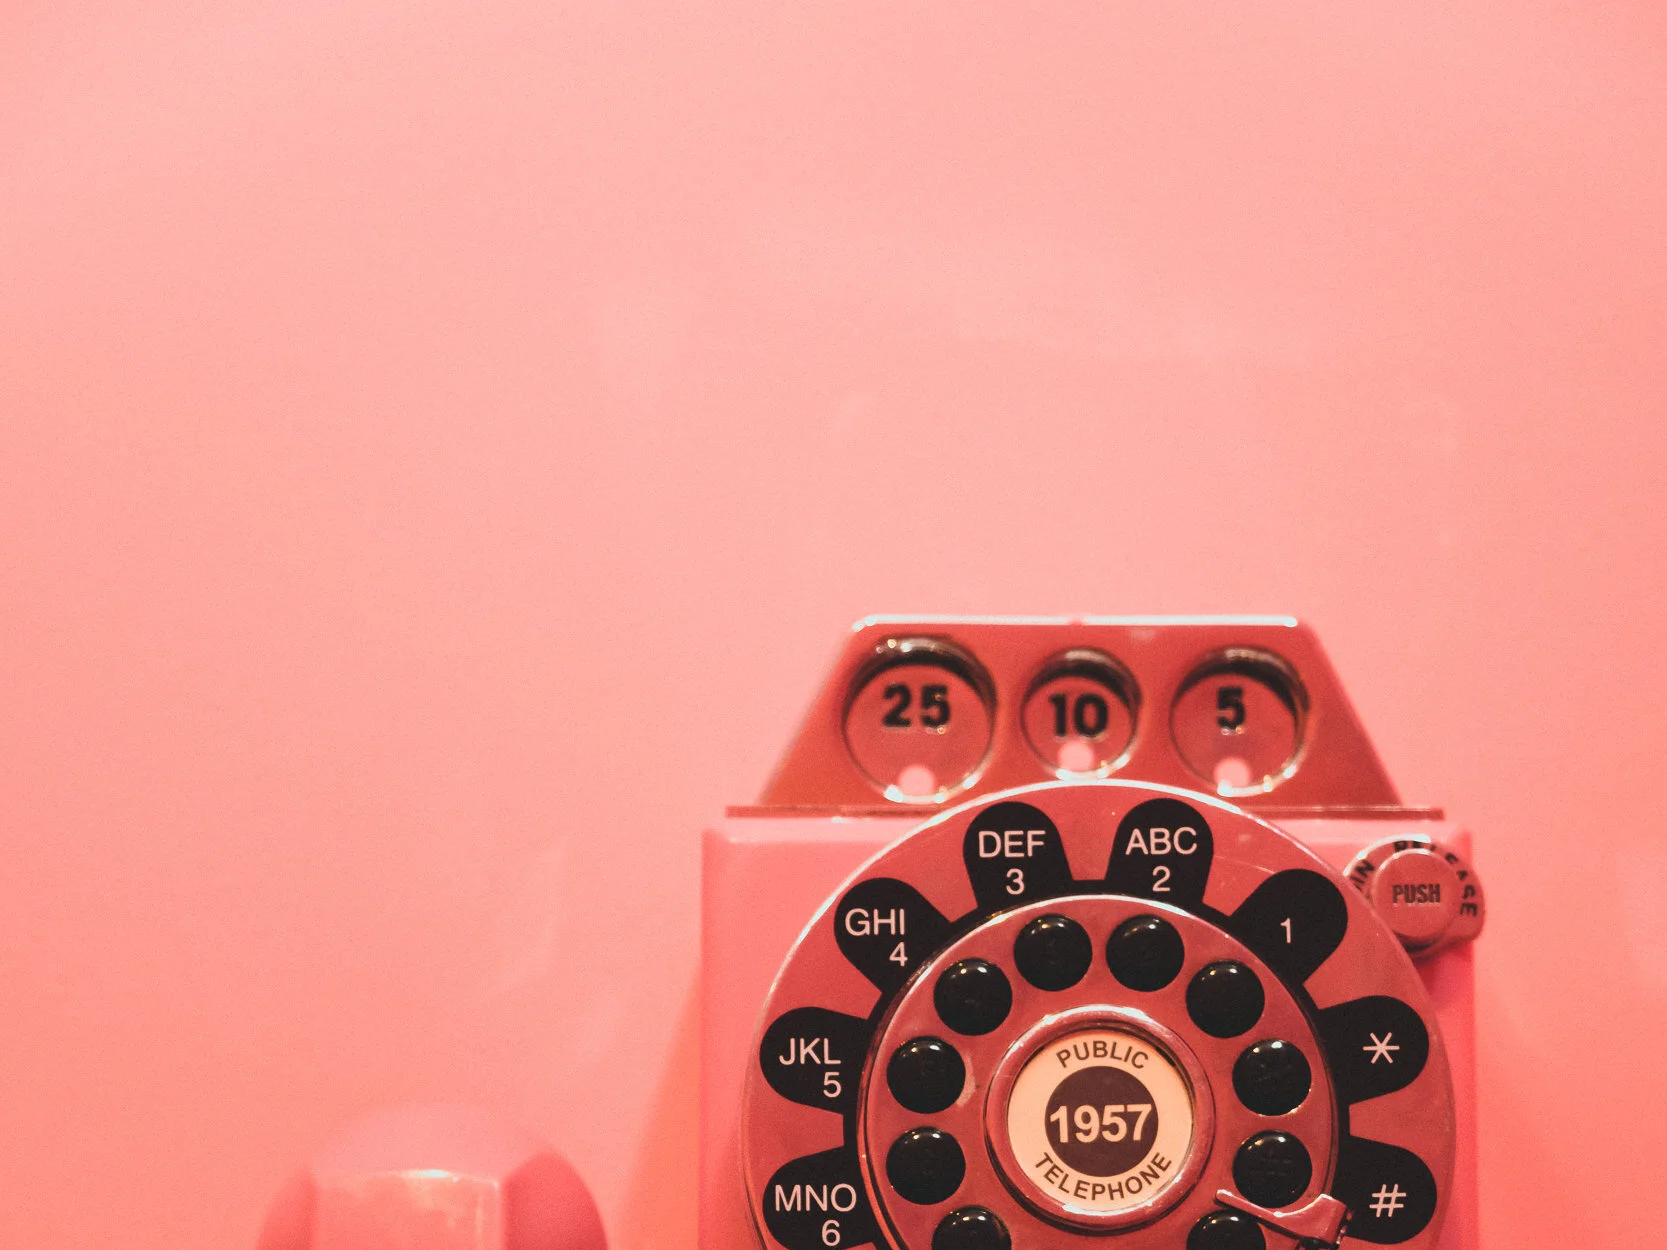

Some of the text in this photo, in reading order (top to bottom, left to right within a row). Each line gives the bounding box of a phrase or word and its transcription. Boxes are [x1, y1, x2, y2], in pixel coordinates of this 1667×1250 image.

[881, 683, 953, 728] 25
[1048, 692, 1109, 738] 10
[1215, 686, 1247, 731] 5
[978, 830, 1046, 858] DEF
[1125, 826, 1198, 855] ABC
[1006, 868, 1025, 895] 3
[1152, 865, 1171, 892] 2
[1392, 883, 1441, 904] PUSH
[845, 908, 905, 937] GHI
[1280, 917, 1291, 944] 1
[889, 941, 908, 967] 4
[779, 1037, 842, 1066] JKL
[1055, 1040, 1149, 1069] PUBLIC
[823, 1071, 842, 1098] 5
[1049, 1103, 1153, 1144] 1957
[1034, 1151, 1172, 1201] TELEPHONE
[775, 1183, 857, 1212] MNO
[1369, 1183, 1407, 1218] #
[821, 1219, 841, 1247] 6
